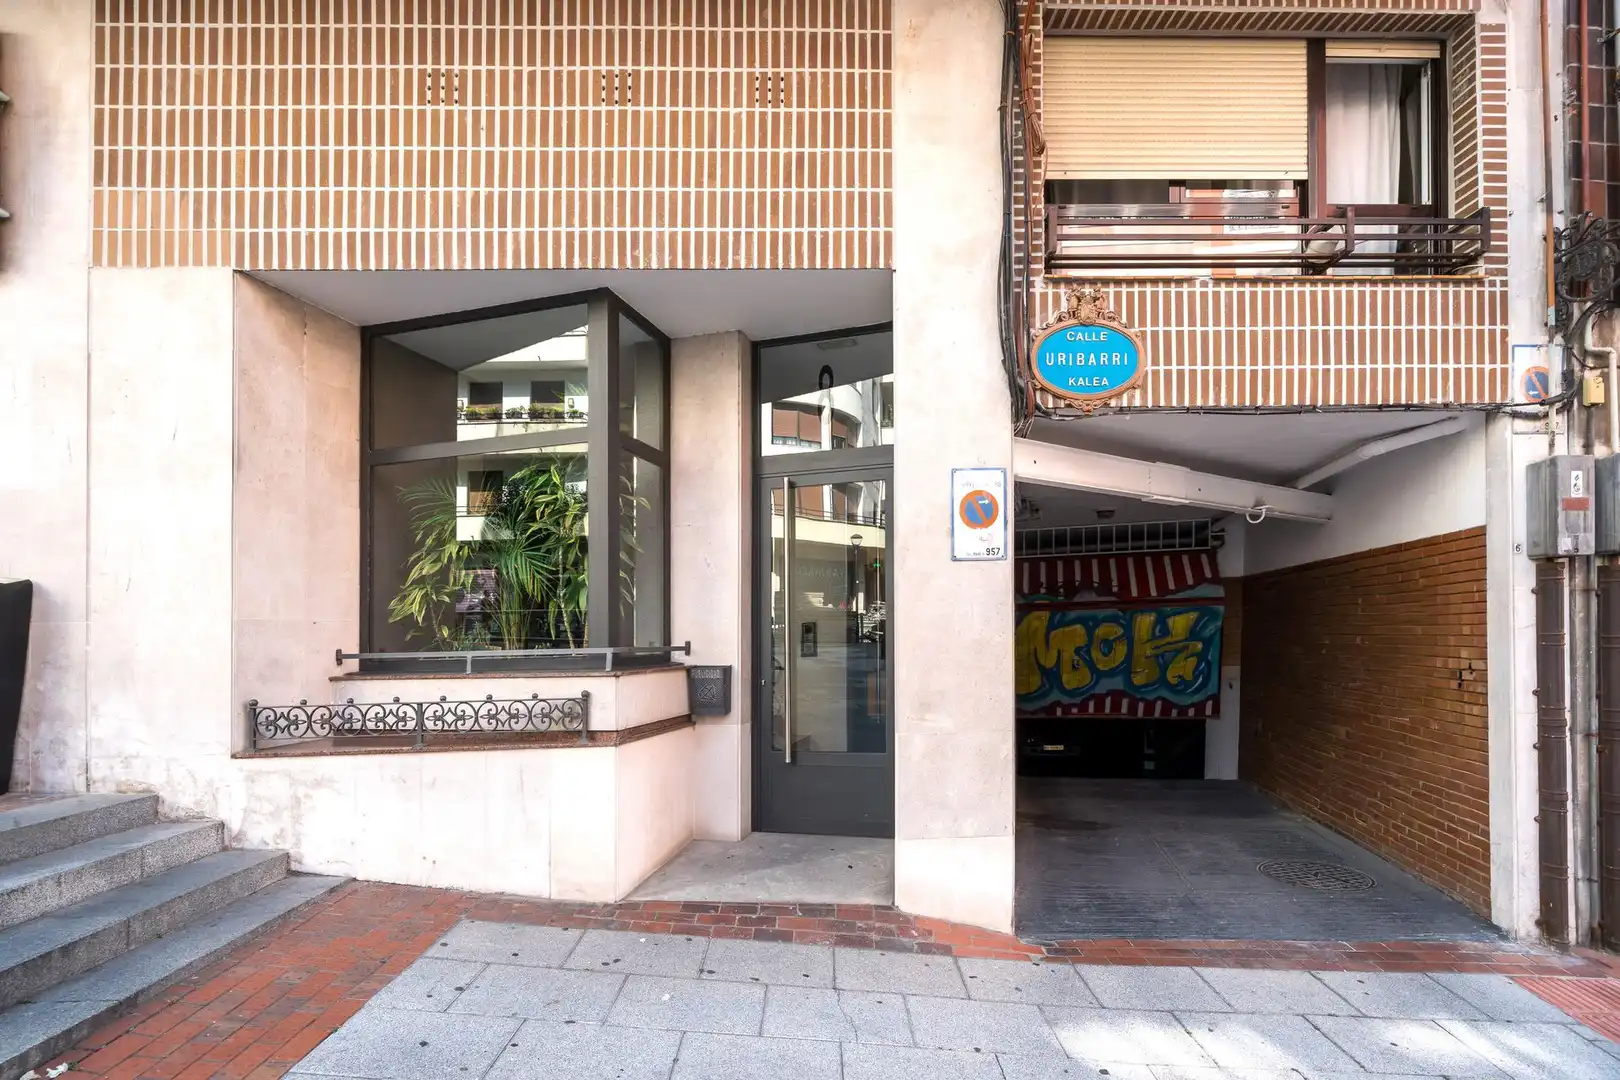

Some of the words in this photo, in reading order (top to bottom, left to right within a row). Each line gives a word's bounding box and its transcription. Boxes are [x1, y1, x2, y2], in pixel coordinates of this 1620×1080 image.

[1066, 331, 1108, 342] CALLE
[1045, 352, 1129, 366] URIBARRI
[1068, 376, 1109, 387] KALEA
[985, 547, 1001, 556] 957
[1515, 544, 1521, 552] 6
